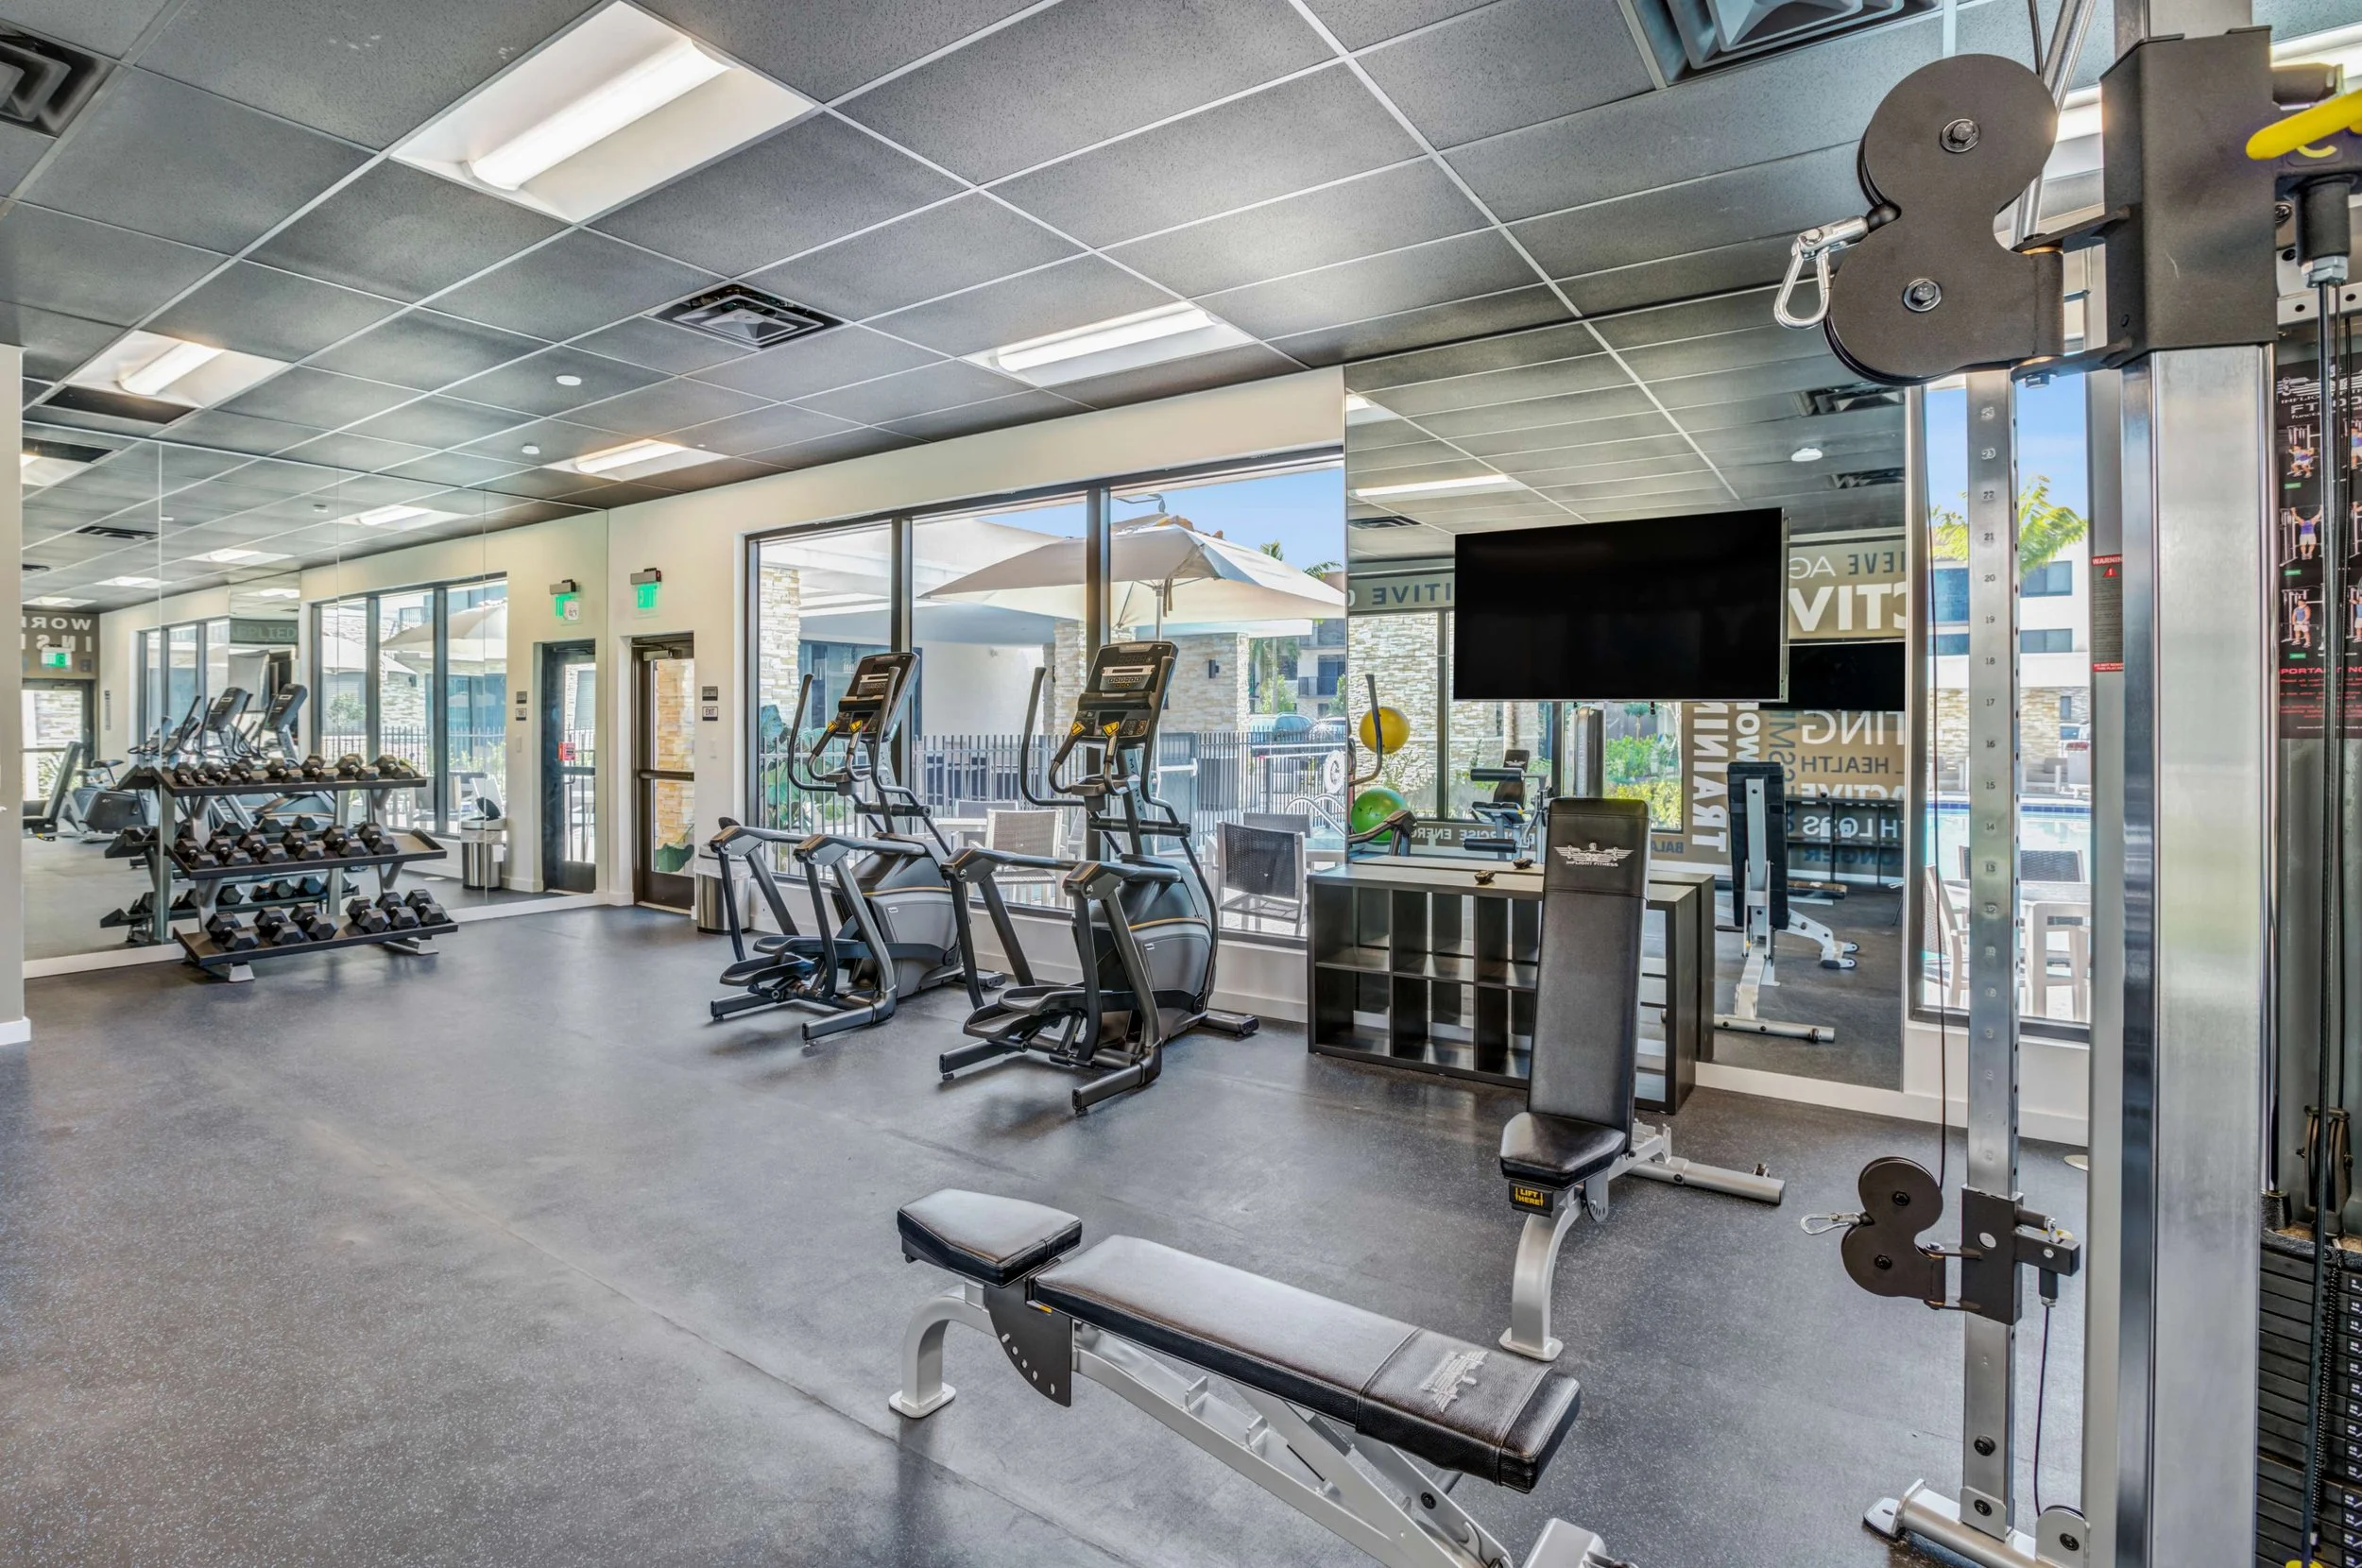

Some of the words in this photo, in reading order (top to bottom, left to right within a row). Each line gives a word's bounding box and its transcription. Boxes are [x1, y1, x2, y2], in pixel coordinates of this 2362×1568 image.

[1984, 574, 1996, 583] 20
[1519, 1188, 1538, 1199] LIFT
[1517, 1195, 1540, 1206] HERE
